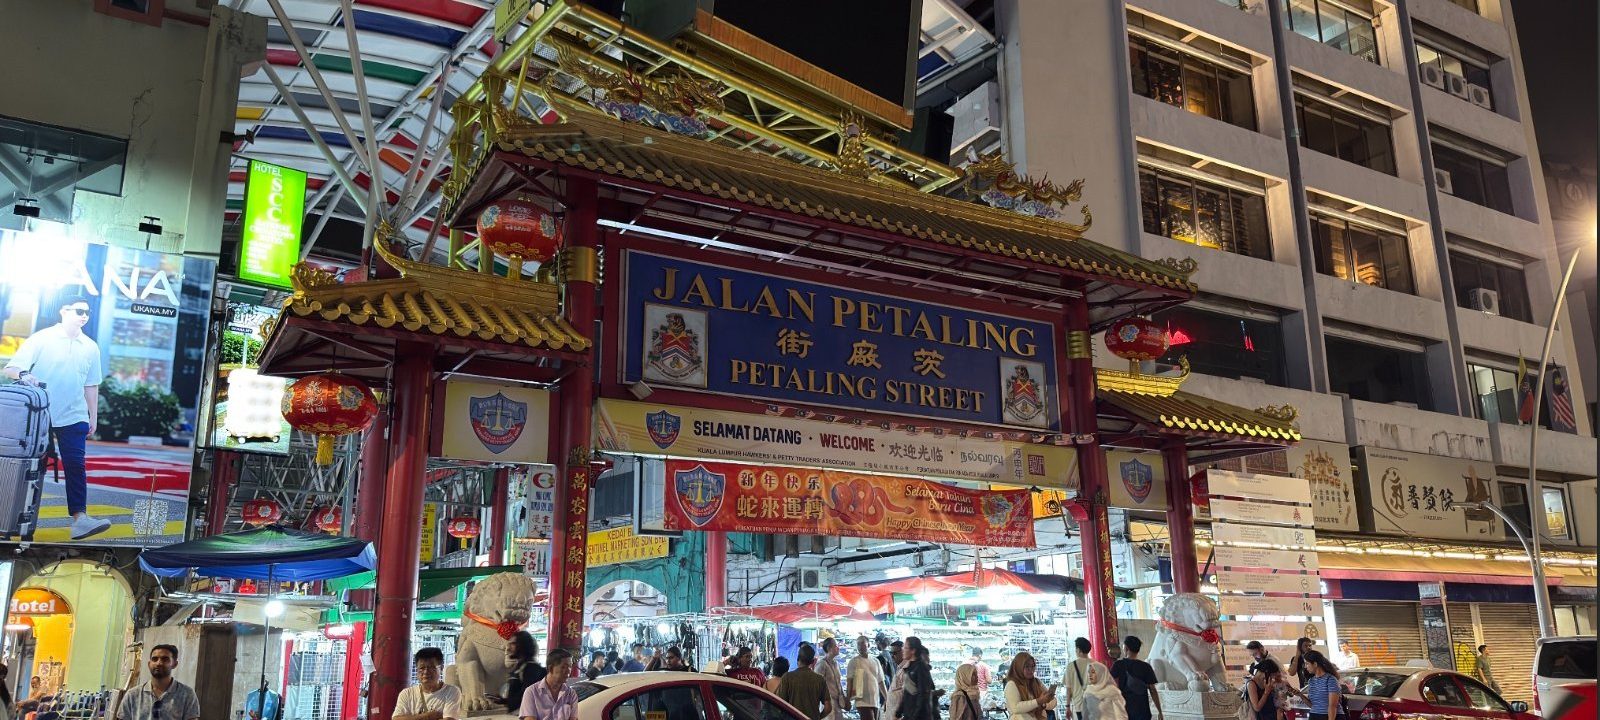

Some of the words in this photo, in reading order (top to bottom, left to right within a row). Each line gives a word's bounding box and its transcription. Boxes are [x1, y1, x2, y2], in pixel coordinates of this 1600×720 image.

[253, 163, 283, 177] HOTEL
[133, 305, 175, 317] UKANA.MY
[653, 266, 817, 323] JALAN
[829, 295, 1039, 357] PETALING
[730, 359, 877, 400] PETALING
[885, 379, 985, 413] STREET
[693, 420, 751, 441] SELAMAT
[753, 426, 802, 445] DATANG
[819, 432, 876, 453] WELCOME
[697, 447, 718, 455] KUALA
[719, 449, 742, 457] LUMPUR
[742, 451, 772, 460] HAWKERS'
[822, 458, 856, 467] ASSOCIATION
[888, 441, 944, 463] 欢迎光临
[740, 471, 821, 491] 新年快乐
[904, 485, 943, 500] Selamat
[946, 490, 971, 504] Tahun
[736, 494, 825, 521] 蛇來運轉
[928, 499, 952, 512] Baru
[953, 502, 975, 514] Cina
[886, 516, 912, 530] Happy
[957, 520, 975, 532] Year
[608, 528, 626, 541] KEDAI
